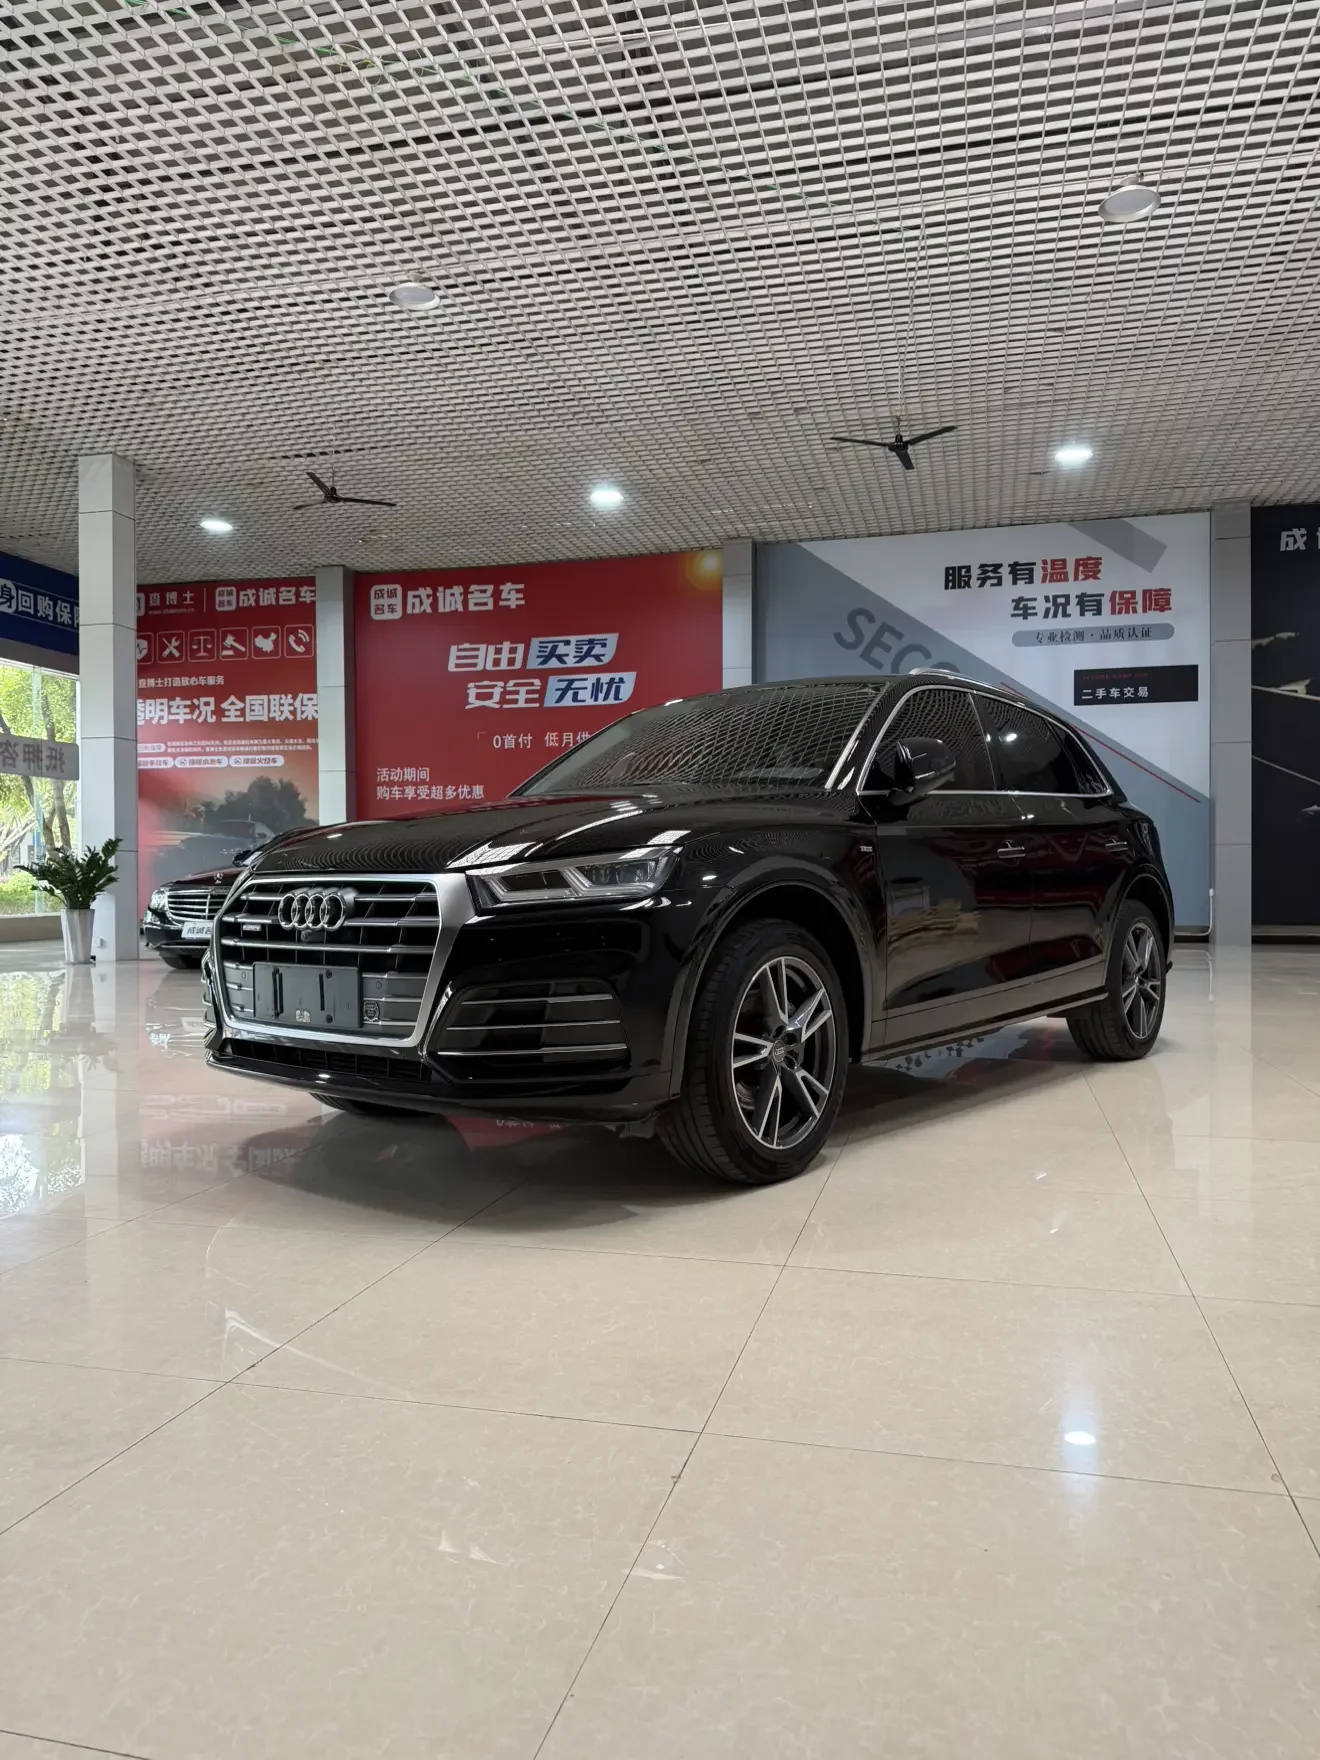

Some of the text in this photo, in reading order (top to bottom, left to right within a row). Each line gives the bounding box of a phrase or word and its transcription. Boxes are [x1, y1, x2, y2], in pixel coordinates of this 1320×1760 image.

[1279, 527, 1320, 552] 成
[944, 556, 1104, 591] 服务有温度
[148, 590, 195, 607] 查博士
[239, 585, 317, 608] 成诚名车
[373, 587, 399, 601] 成诚
[406, 582, 526, 615] 成诚名车
[373, 602, 399, 616] 名车
[1010, 588, 1173, 621] 车况有保障
[138, 674, 225, 689] 查博士打造放心车服务
[1081, 685, 1149, 700] 二手车交易
[220, 692, 318, 723] 全国联保
[493, 733, 533, 750] 0首付
[376, 766, 430, 783] 活动期间
[376, 784, 485, 801] 购车享受超多优惠
